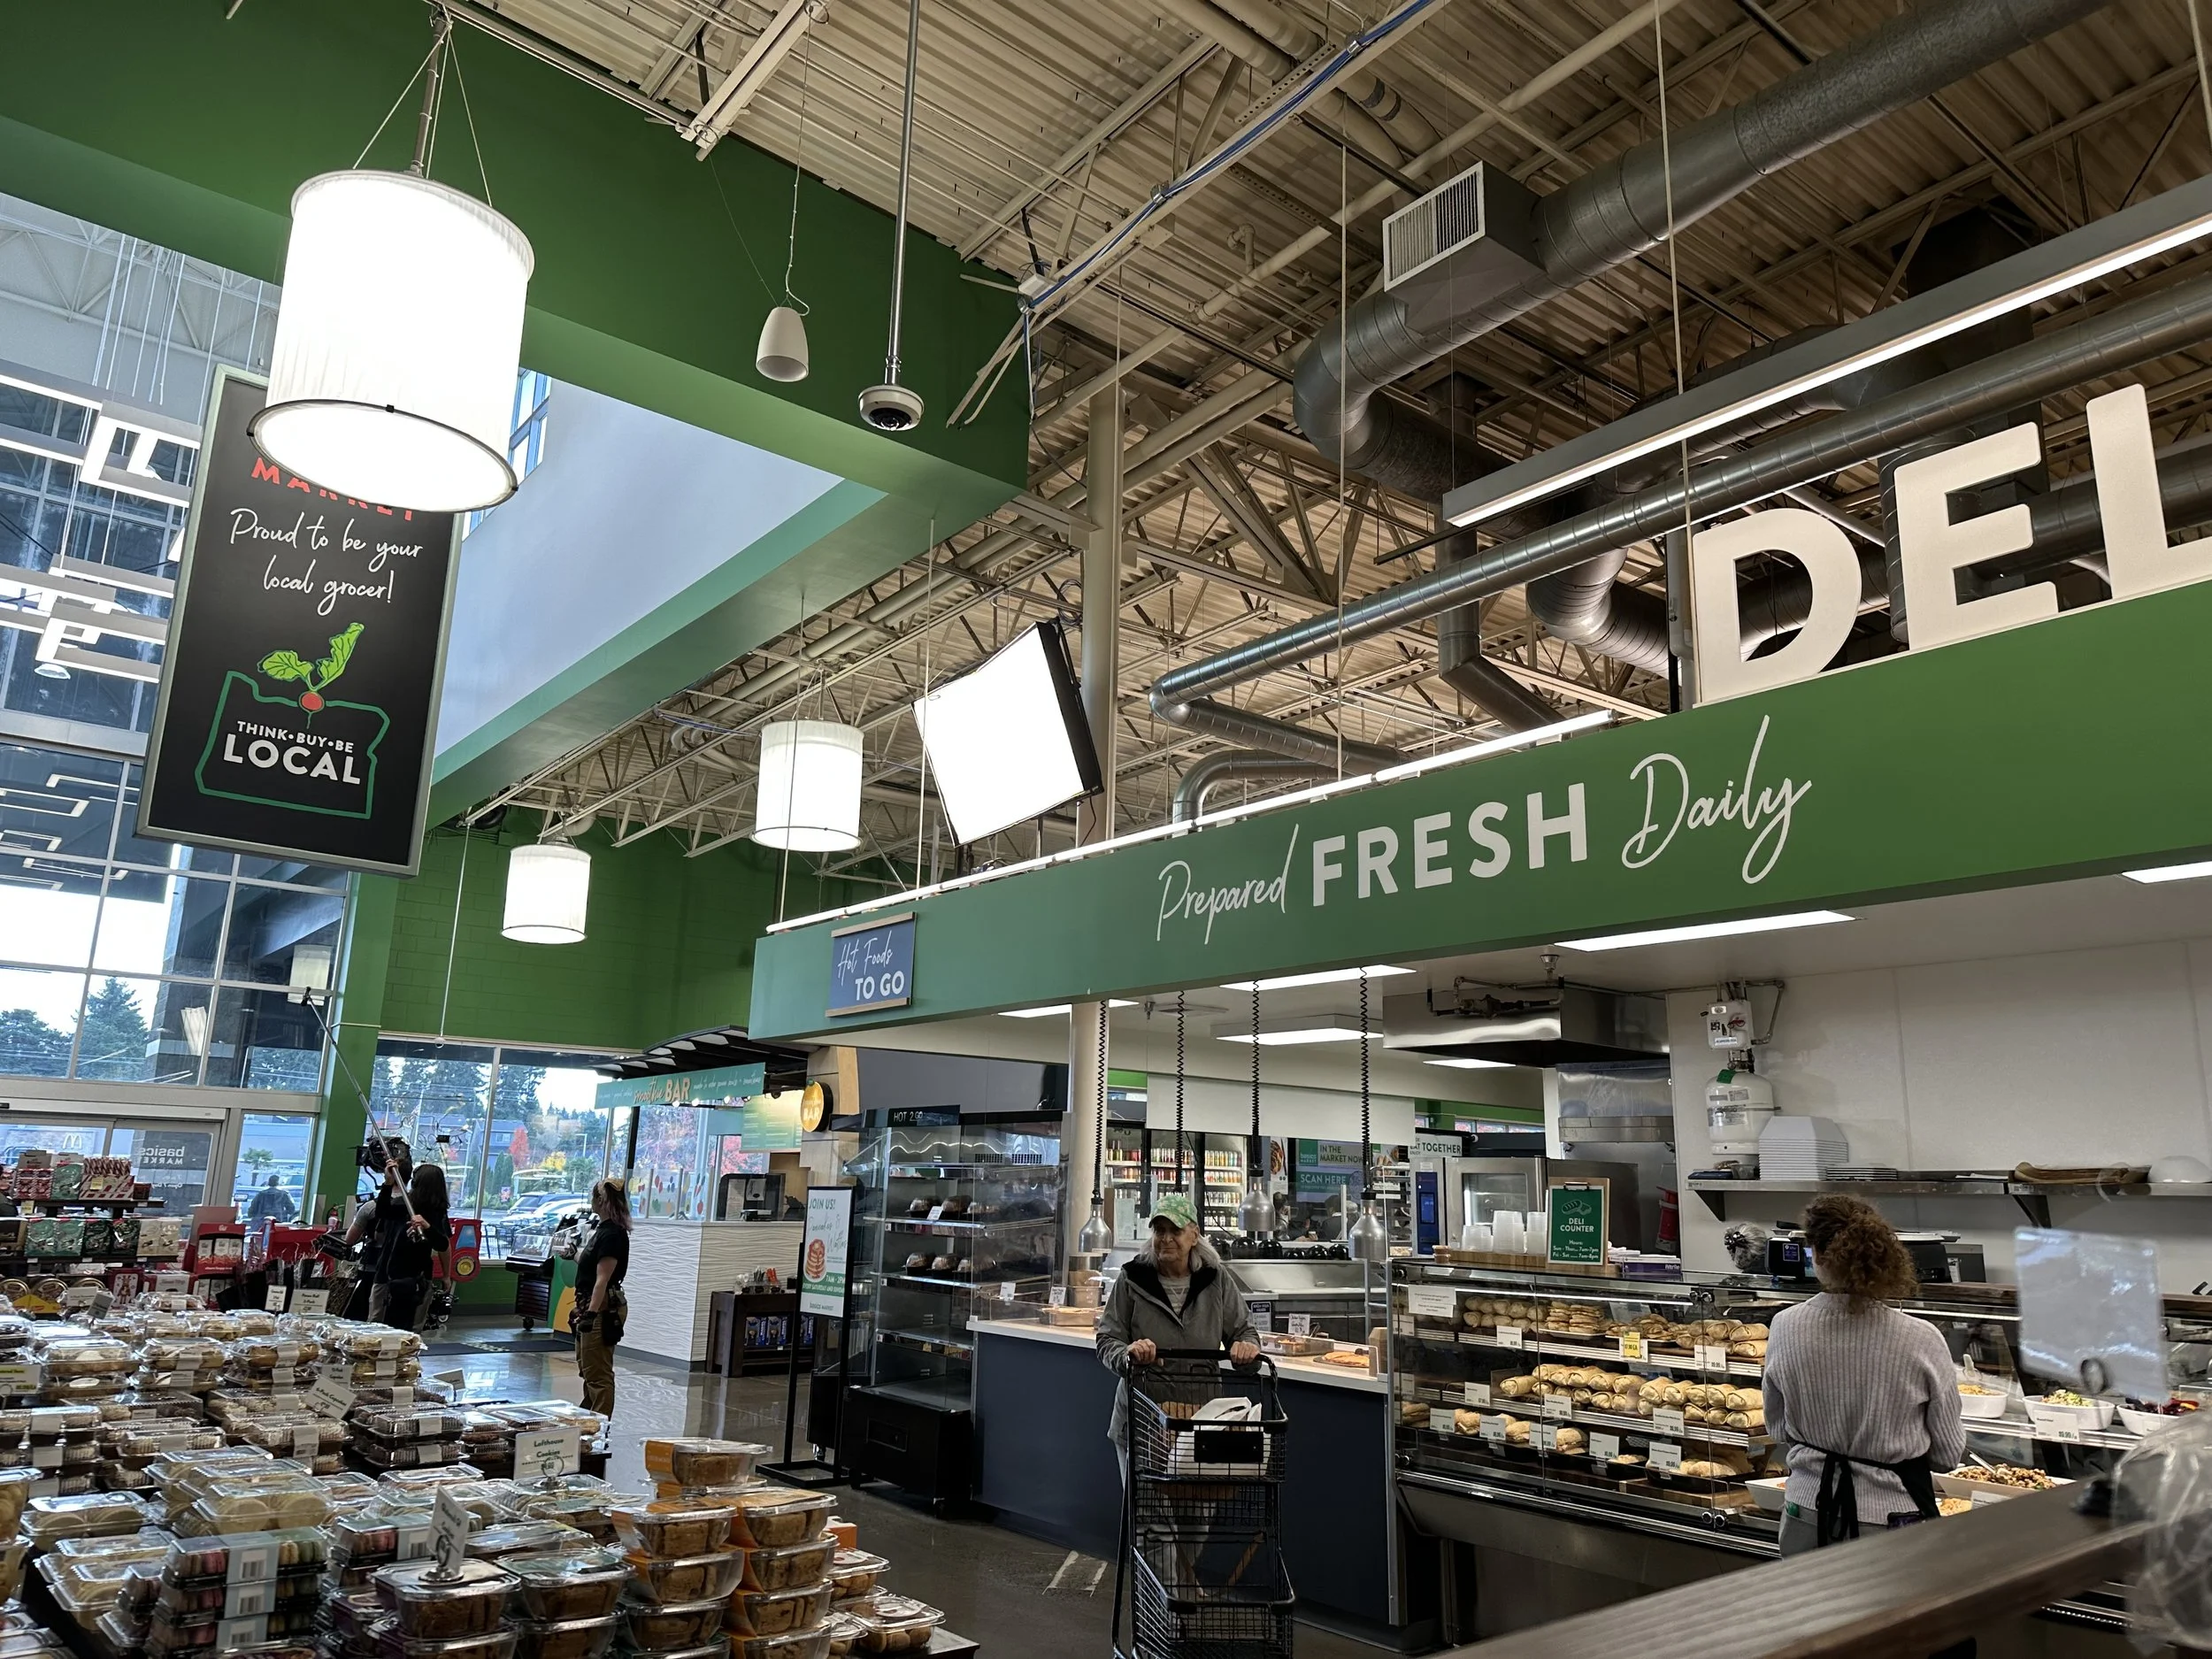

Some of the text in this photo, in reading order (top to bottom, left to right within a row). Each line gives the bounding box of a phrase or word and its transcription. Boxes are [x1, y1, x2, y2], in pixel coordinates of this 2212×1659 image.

[230, 507, 424, 573] Proud to be your
[1693, 383, 2212, 704] DEL
[264, 555, 395, 616] local grocer!
[223, 733, 361, 785] LOCAL
[1156, 714, 1812, 945] Prepared FRESH Daily
[837, 930, 894, 987] Hot Foods
[855, 970, 905, 1001] TO GO
[665, 1078, 691, 1102] BAR
[894, 1111, 907, 1122] HOT
[1320, 1154, 1346, 1163] MARKET
[1328, 1145, 1341, 1154] THE
[1422, 1142, 1461, 1155] TOGETHER
[1300, 1174, 1346, 1184] SCAN HERE
[810, 1198, 824, 1210] JOIN
